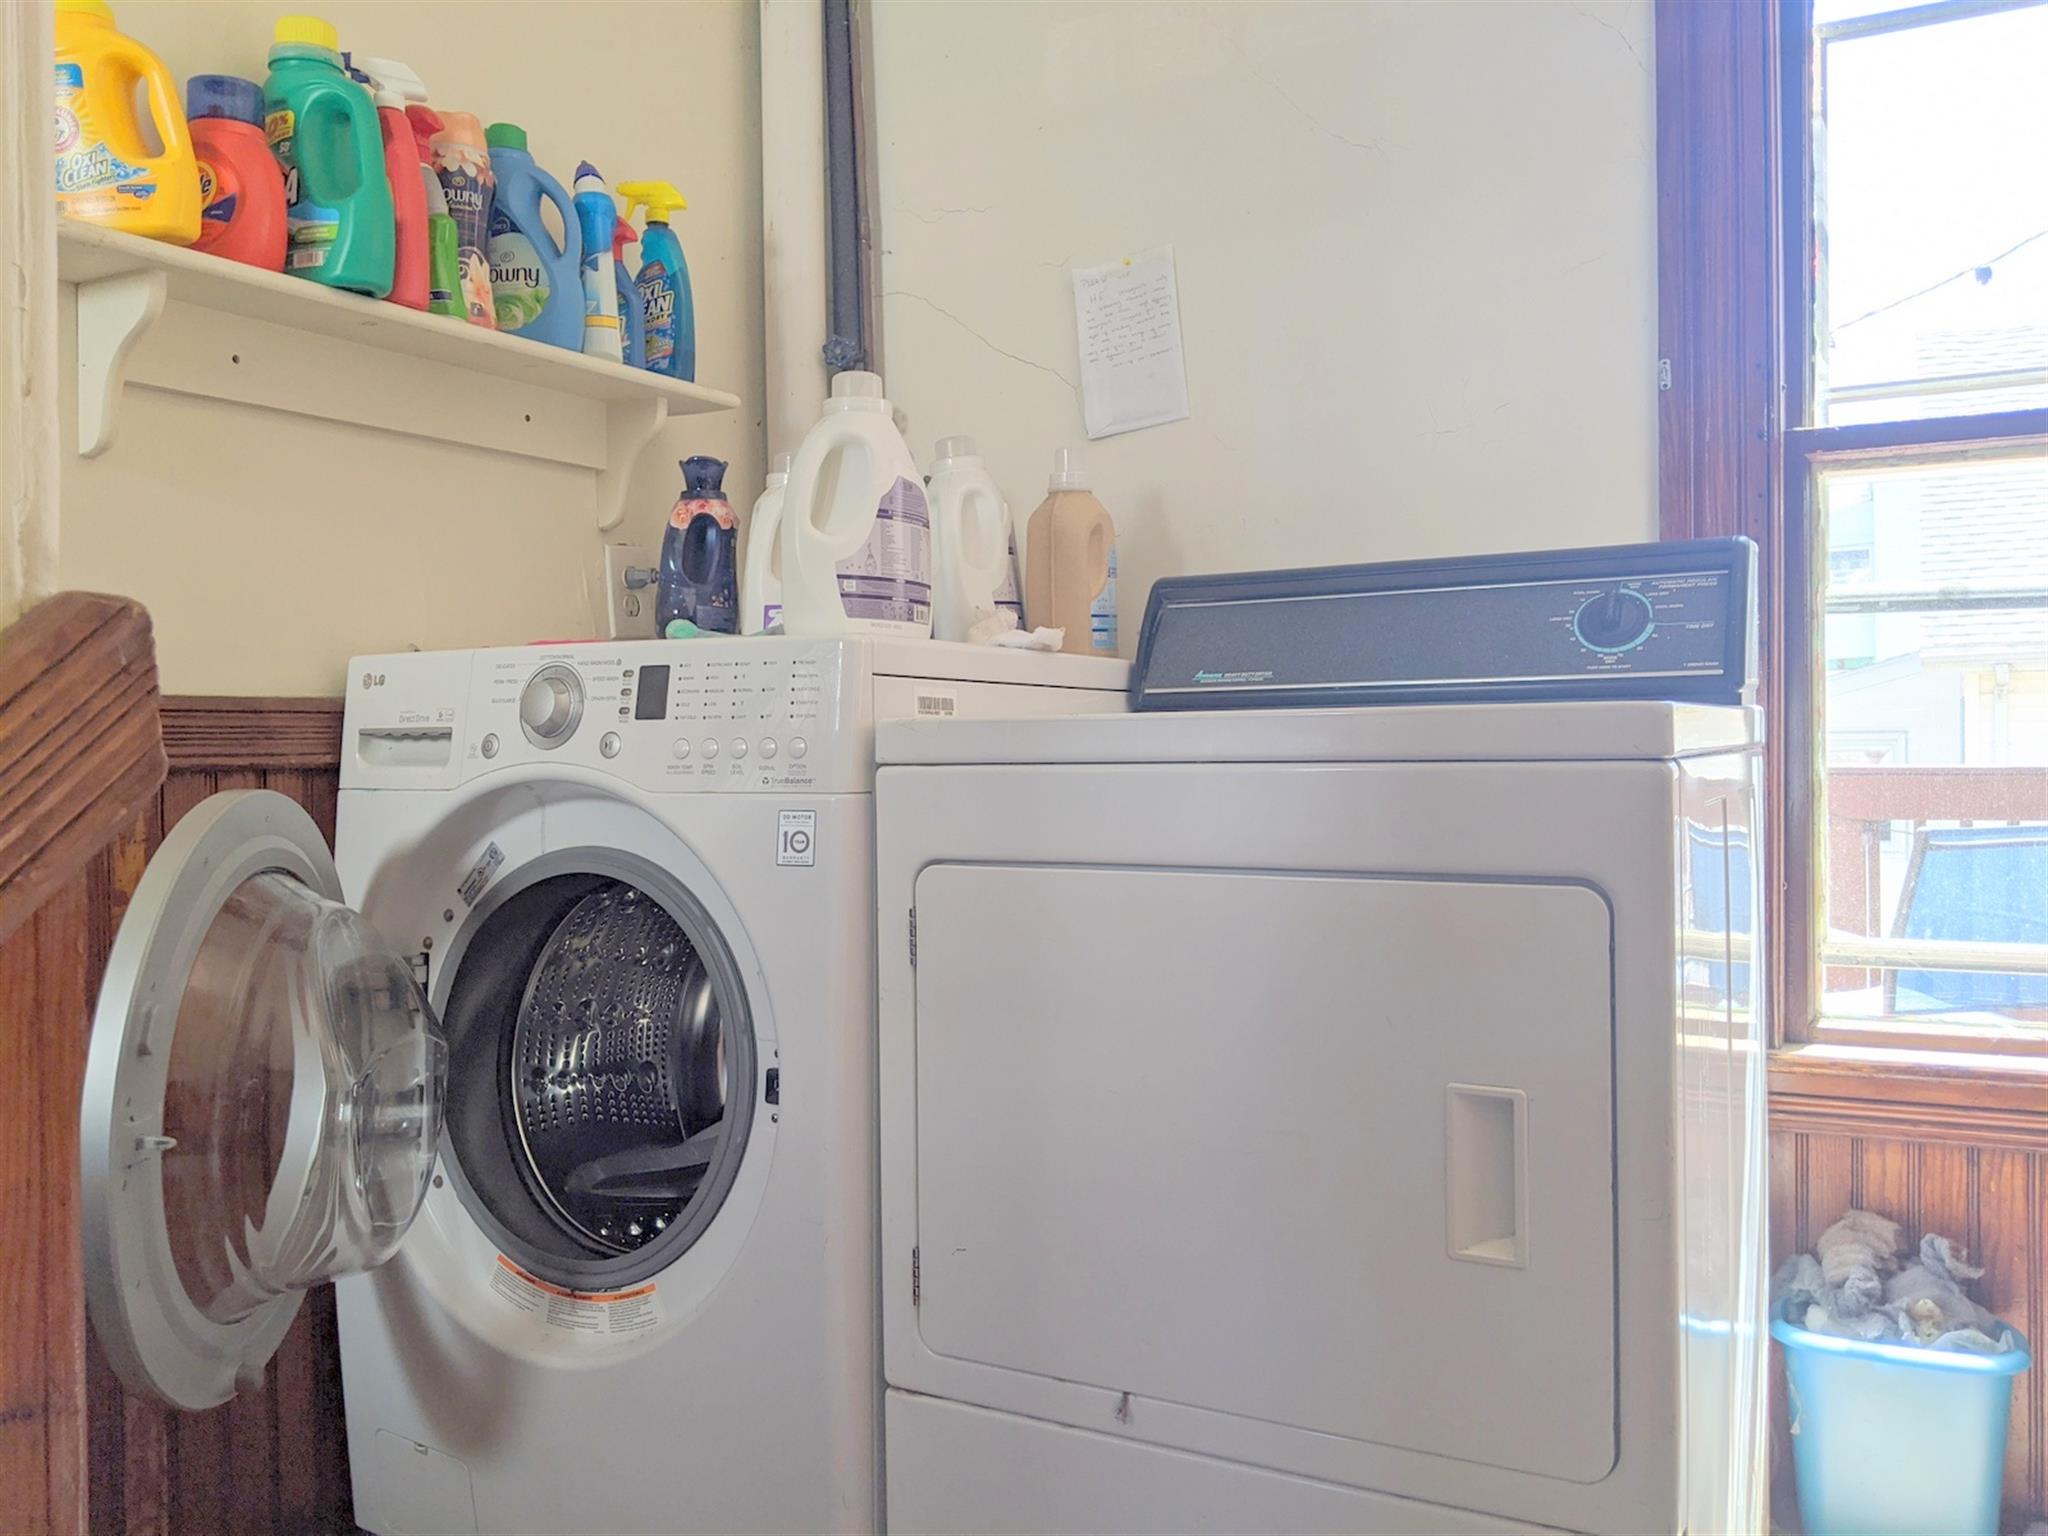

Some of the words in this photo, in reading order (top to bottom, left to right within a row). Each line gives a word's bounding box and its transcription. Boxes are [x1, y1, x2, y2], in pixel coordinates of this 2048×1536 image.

[70, 150, 97, 171] OXI
[63, 159, 108, 188] CLEAN
[443, 188, 483, 211] owny
[490, 266, 540, 288] owny
[374, 673, 386, 687] LG
